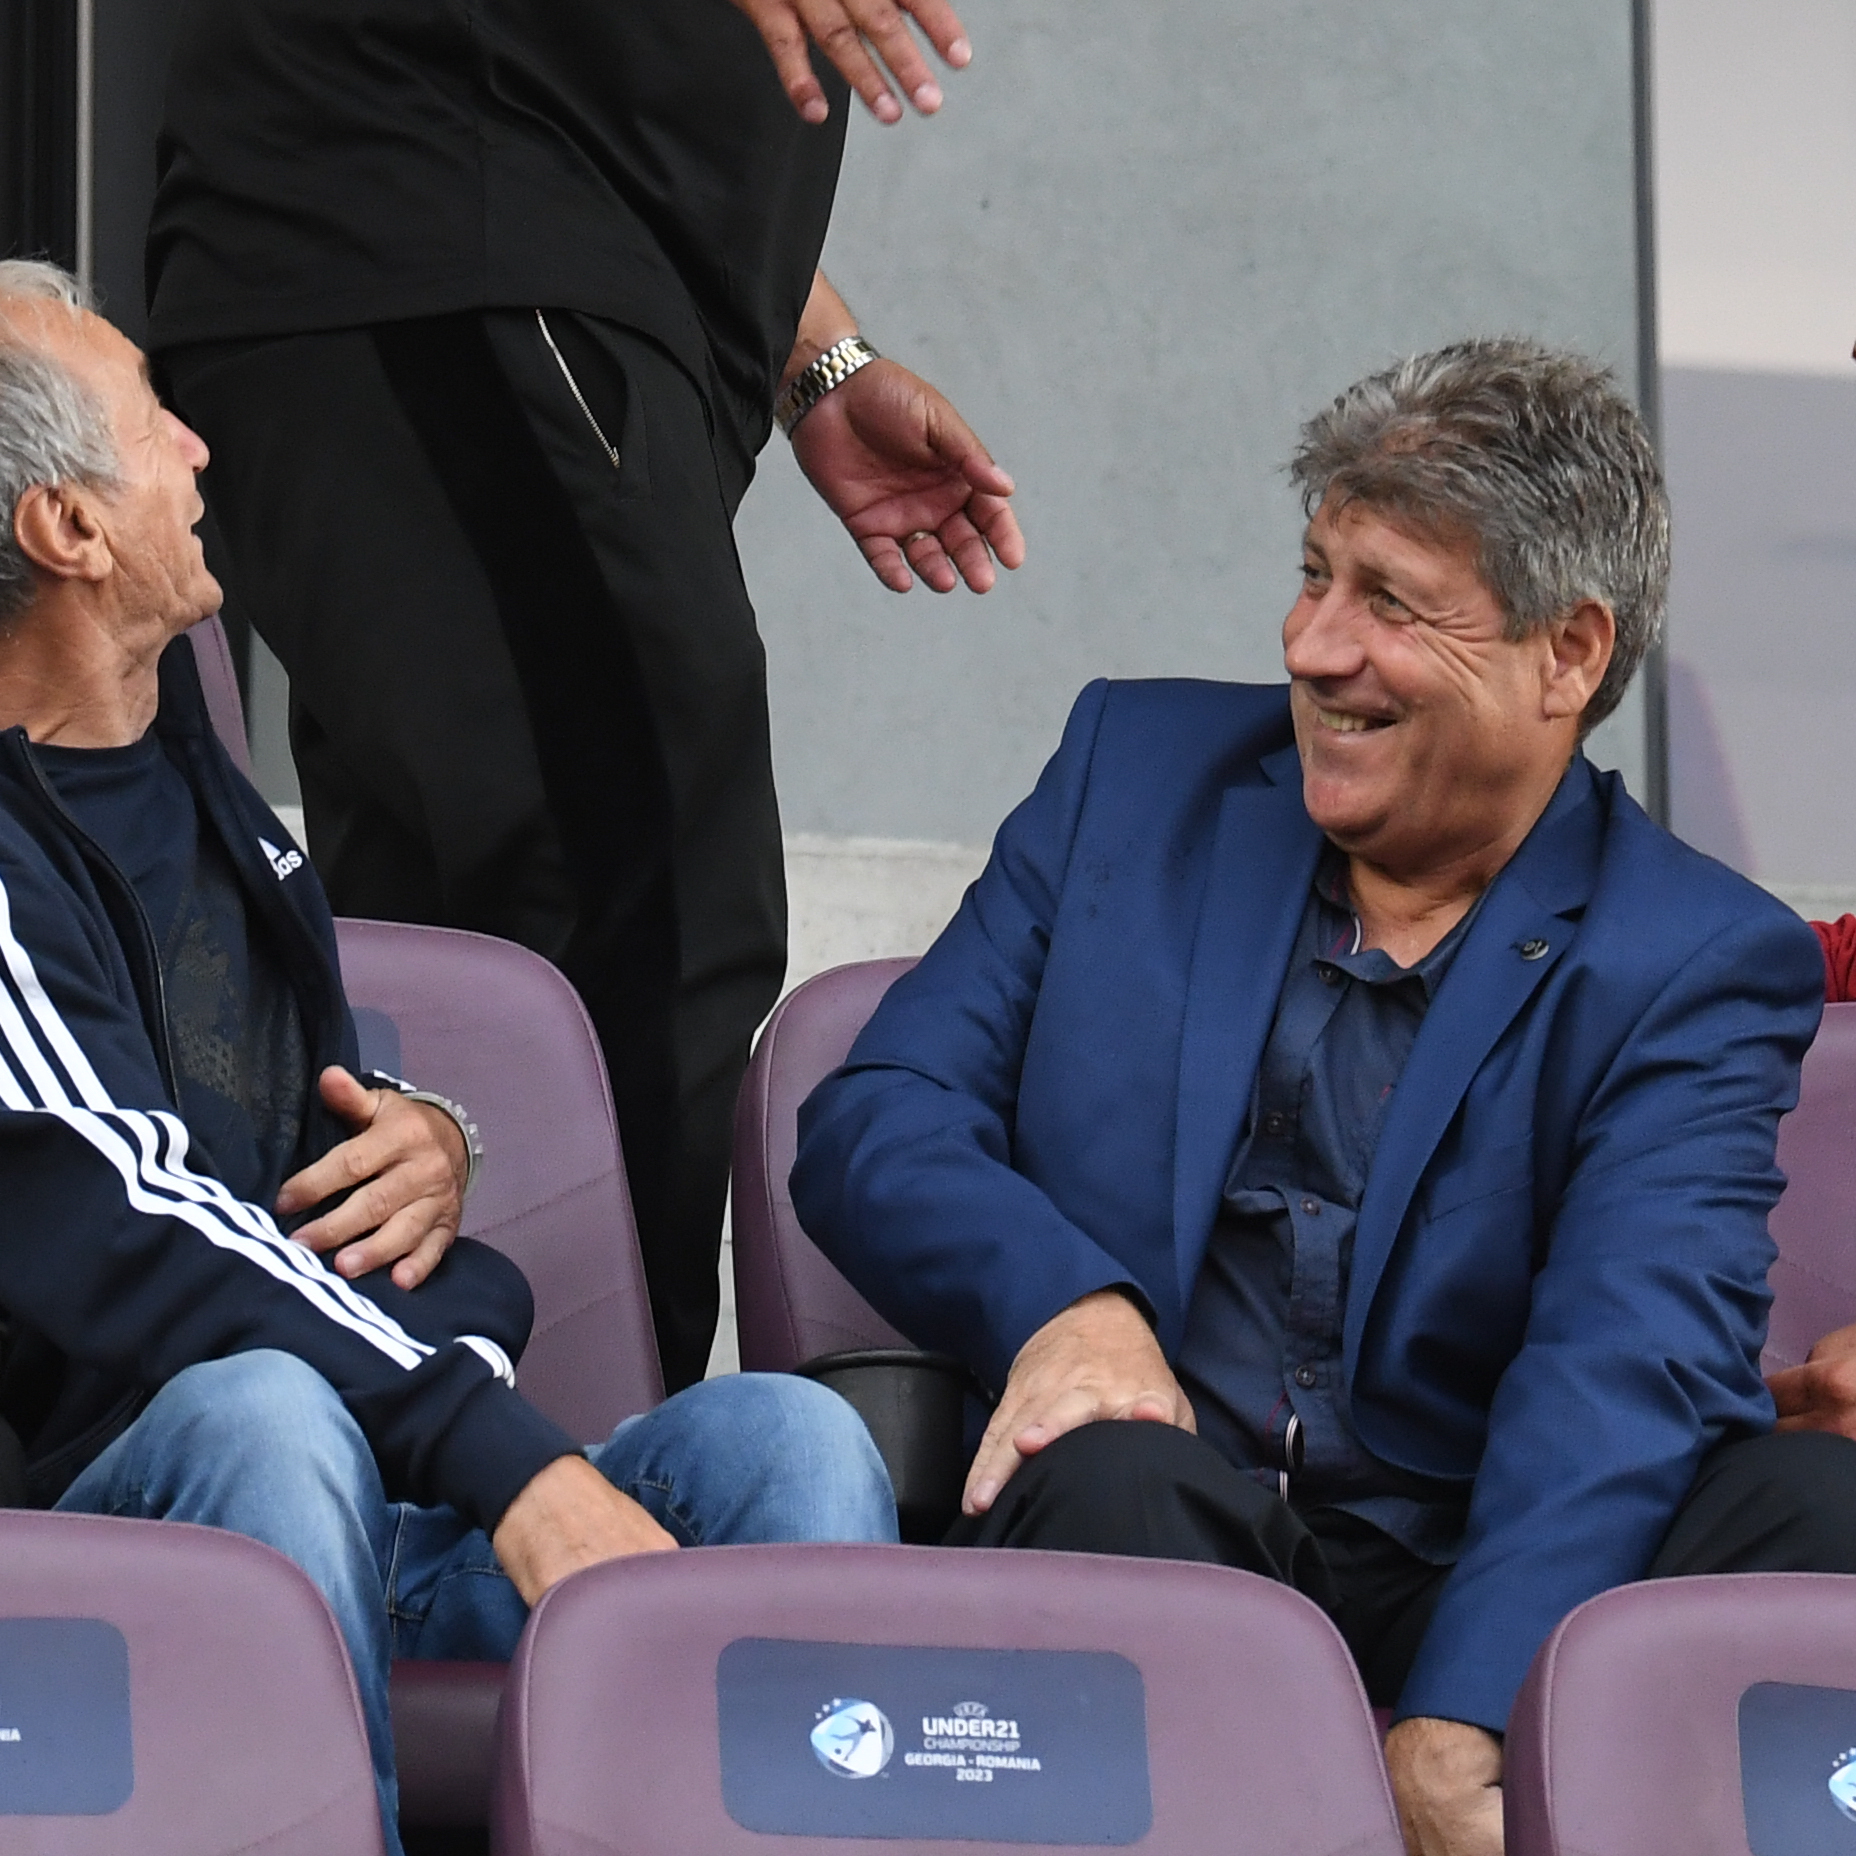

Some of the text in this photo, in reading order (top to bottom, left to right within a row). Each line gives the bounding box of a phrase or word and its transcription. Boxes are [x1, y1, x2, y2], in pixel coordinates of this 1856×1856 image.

[922, 1716, 1021, 1739] UNDER21
[904, 1752, 967, 1767] GEORGIA
[975, 1755, 1042, 1771] ROMANIA
[955, 1768, 994, 1782] 2023
